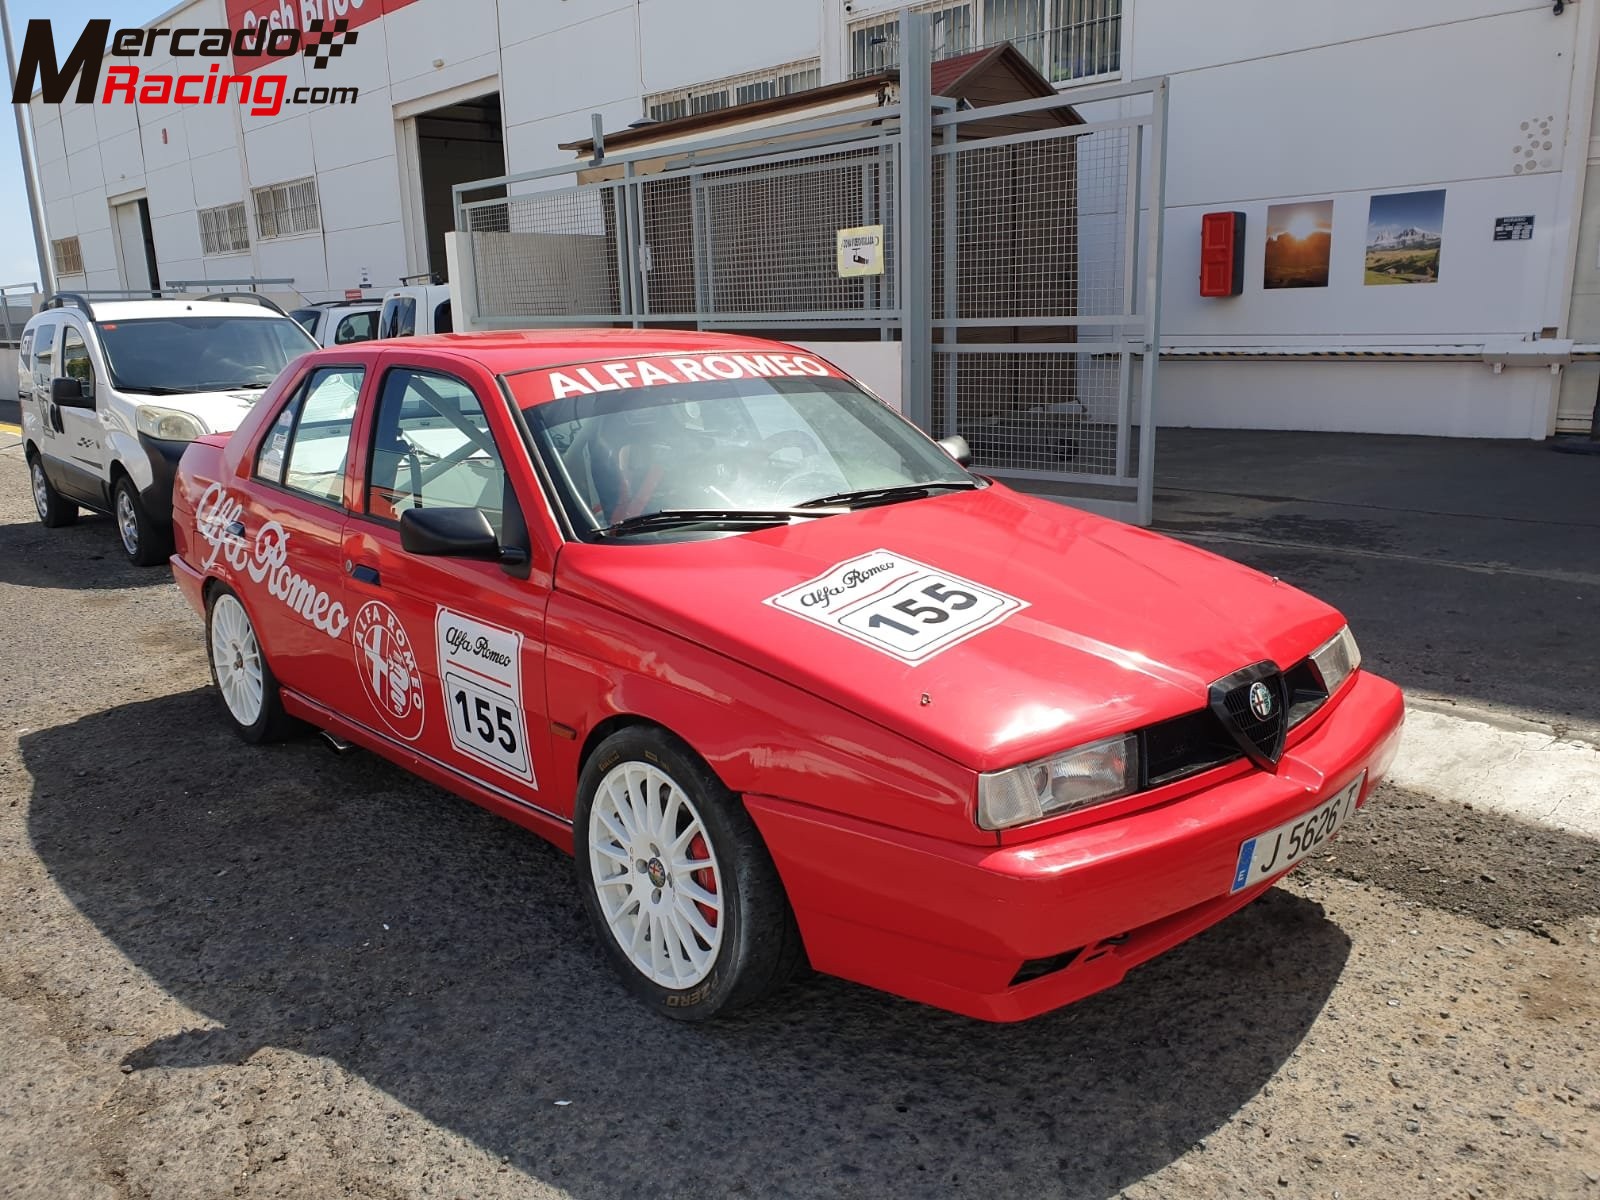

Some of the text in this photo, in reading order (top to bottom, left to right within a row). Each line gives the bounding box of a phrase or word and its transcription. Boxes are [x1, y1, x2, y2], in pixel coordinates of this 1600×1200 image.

[548, 354, 829, 400] ALFA ROMEO
[196, 482, 349, 638] Alfa Romeo
[800, 561, 895, 609] Alfa Romeo
[868, 582, 978, 636] 155
[355, 605, 422, 710] ALFA ROMEO
[445, 626, 512, 668] Alfa Romeo
[454, 690, 517, 754] 155
[1260, 832, 1283, 874] J
[1286, 798, 1342, 861] 5626
[1237, 869, 1247, 882] E
